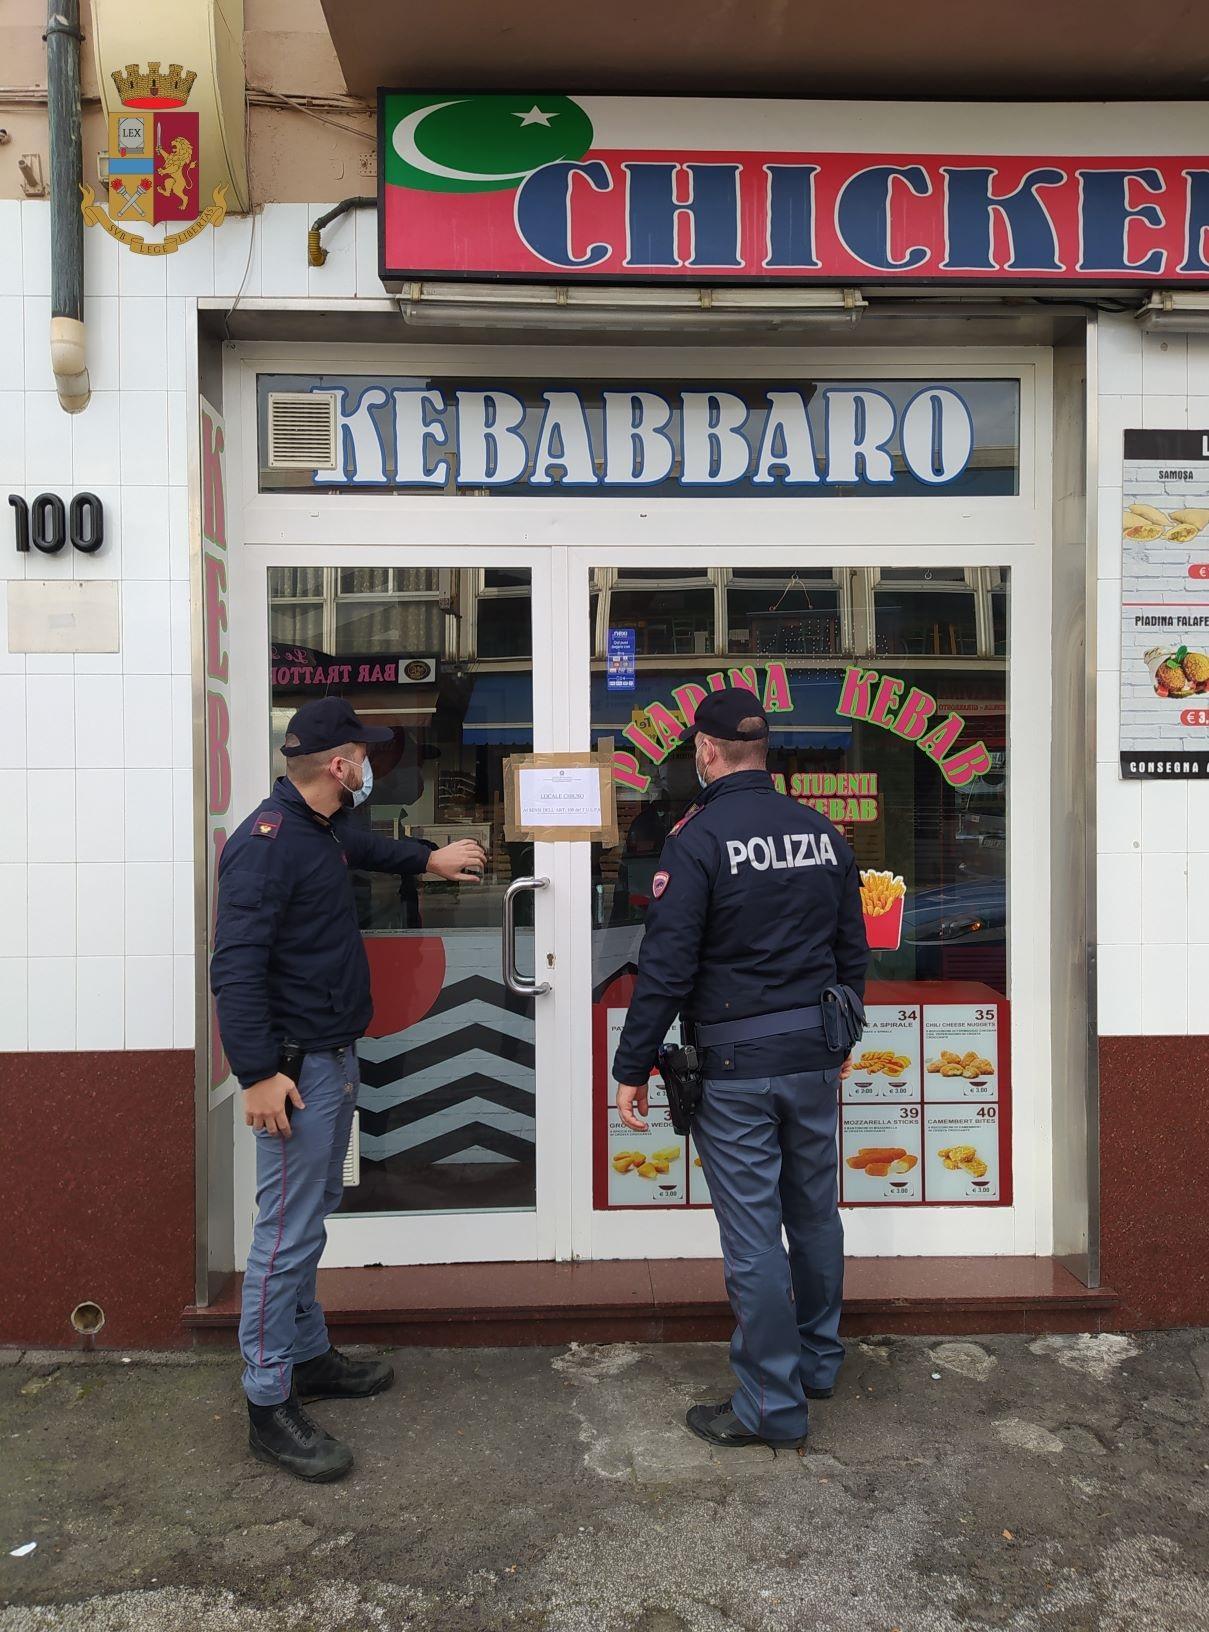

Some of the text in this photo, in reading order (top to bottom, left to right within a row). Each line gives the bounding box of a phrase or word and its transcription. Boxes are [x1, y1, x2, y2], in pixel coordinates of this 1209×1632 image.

[513, 158, 1209, 275] CHICKE
[310, 383, 975, 487] KEBABBARO
[1158, 470, 1194, 480] SAMOSA
[8, 490, 105, 556] 100
[1134, 615, 1174, 627] PIADINA
[1187, 711, 1196, 724] €
[835, 664, 993, 787] KEBAB
[201, 409, 233, 1093] KEB
[1129, 761, 1200, 773] CONSEGNA
[790, 772, 878, 796] STUDENTI
[726, 833, 838, 875] POLIZIA
[897, 1010, 918, 1021] 34
[974, 1009, 995, 1021] 35
[900, 1107, 919, 1119] 39
[976, 1106, 996, 1118] 40
